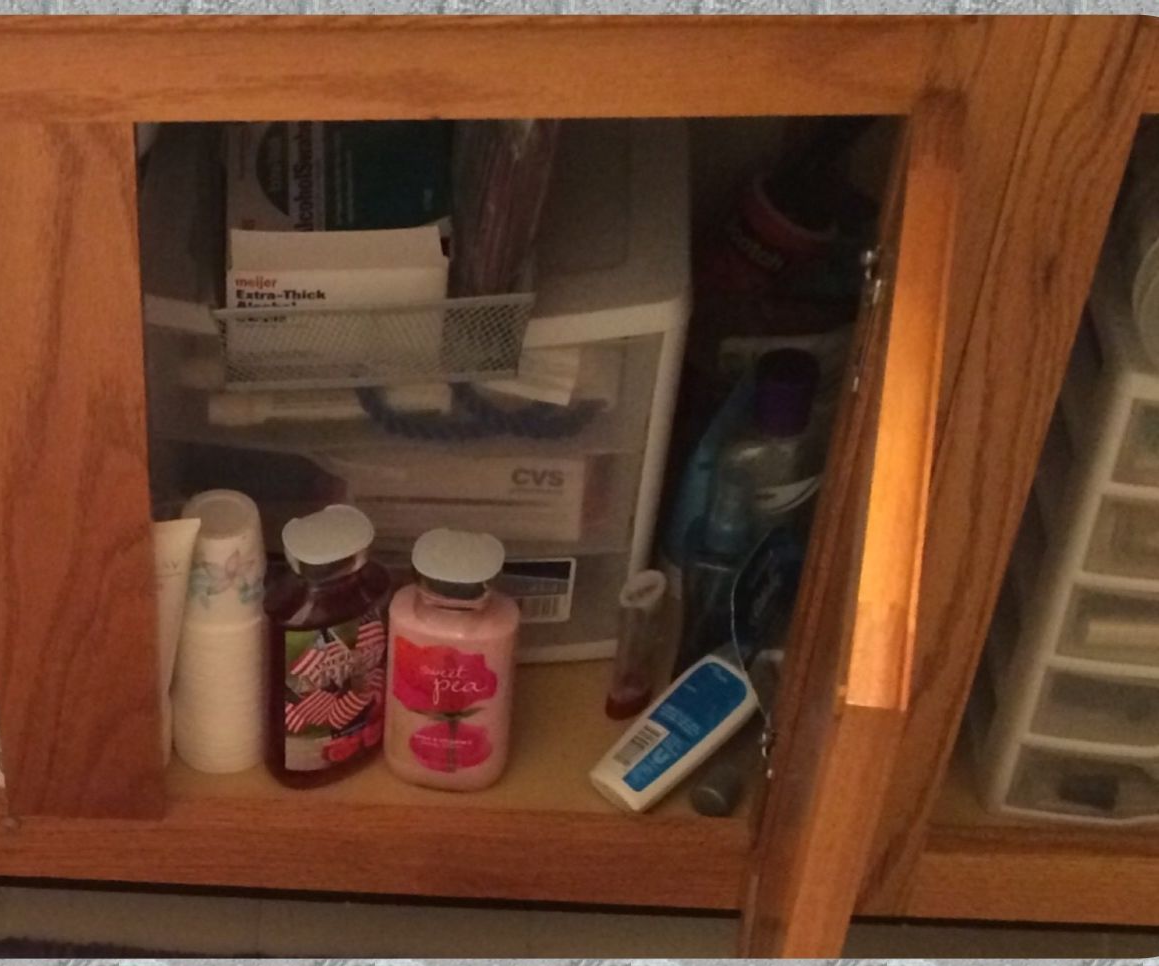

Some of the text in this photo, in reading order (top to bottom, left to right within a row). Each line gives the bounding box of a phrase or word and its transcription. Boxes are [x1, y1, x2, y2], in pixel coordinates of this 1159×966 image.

[235, 275, 277, 289] meijer
[235, 288, 327, 300] Extra-Thick
[511, 468, 565, 487] CVS
[432, 676, 484, 706] pea
